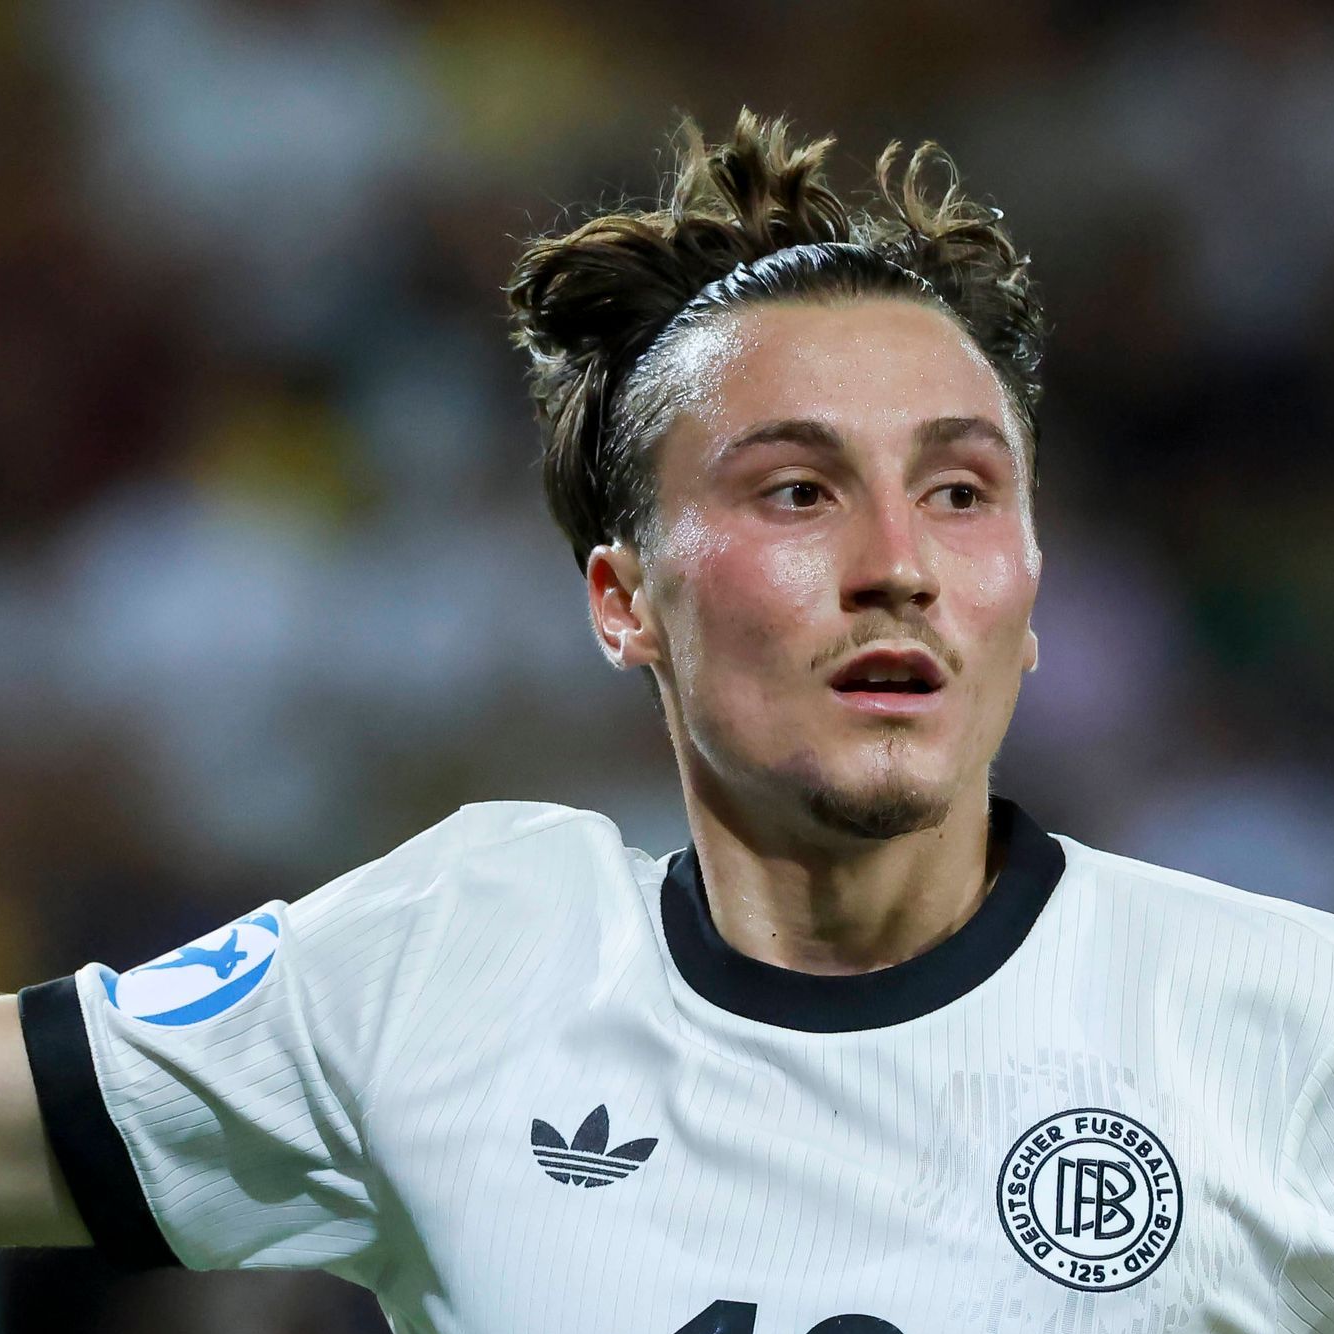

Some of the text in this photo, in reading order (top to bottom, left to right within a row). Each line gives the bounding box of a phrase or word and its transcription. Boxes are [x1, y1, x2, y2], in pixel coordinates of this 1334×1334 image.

[1008, 1117, 1174, 1273] DEUTSCHER FUSSBALL-BUND
[1070, 1261, 1106, 1283] 125
